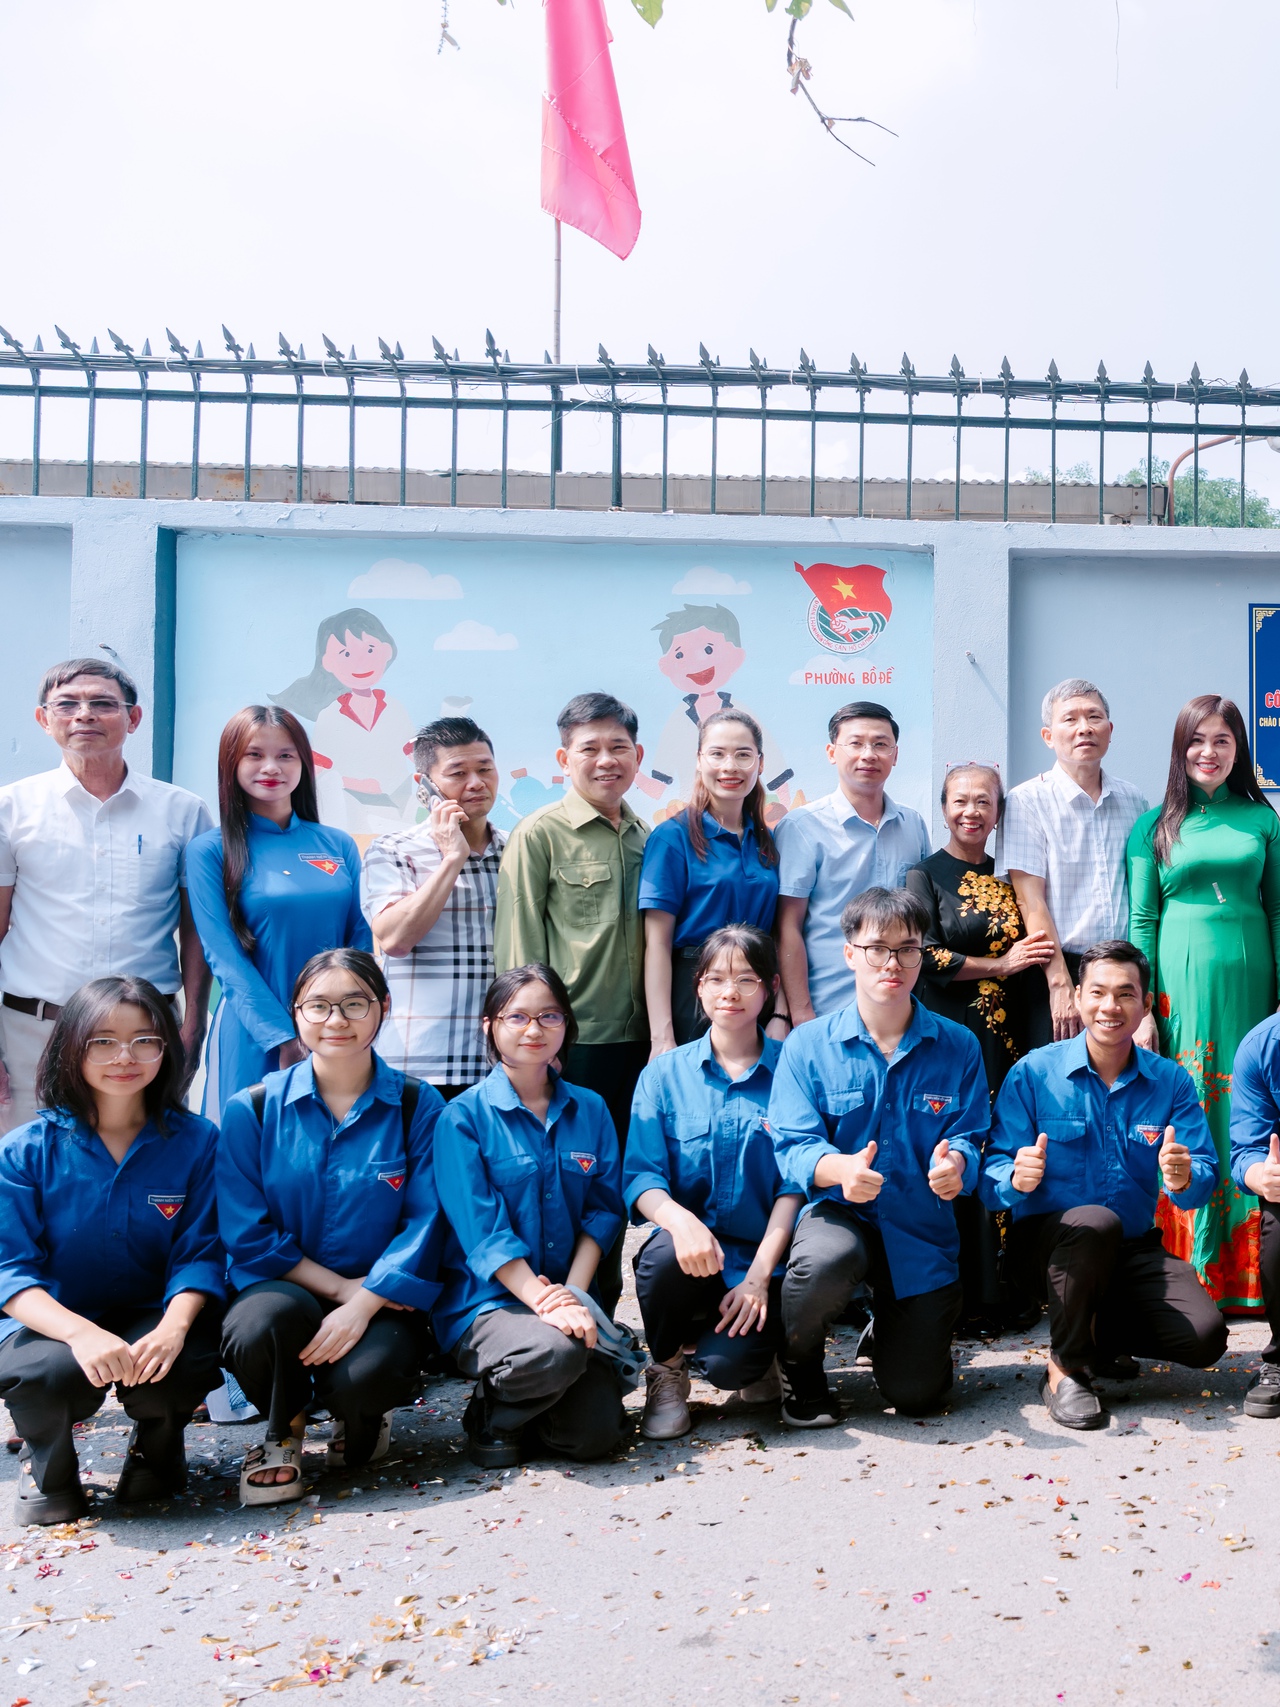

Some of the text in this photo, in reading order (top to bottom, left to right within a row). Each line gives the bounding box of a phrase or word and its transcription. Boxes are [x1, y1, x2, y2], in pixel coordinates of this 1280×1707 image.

[804, 666, 895, 685] PHƯỜNG BỒ ĐỀ
[1259, 716, 1277, 727] CHÀO
